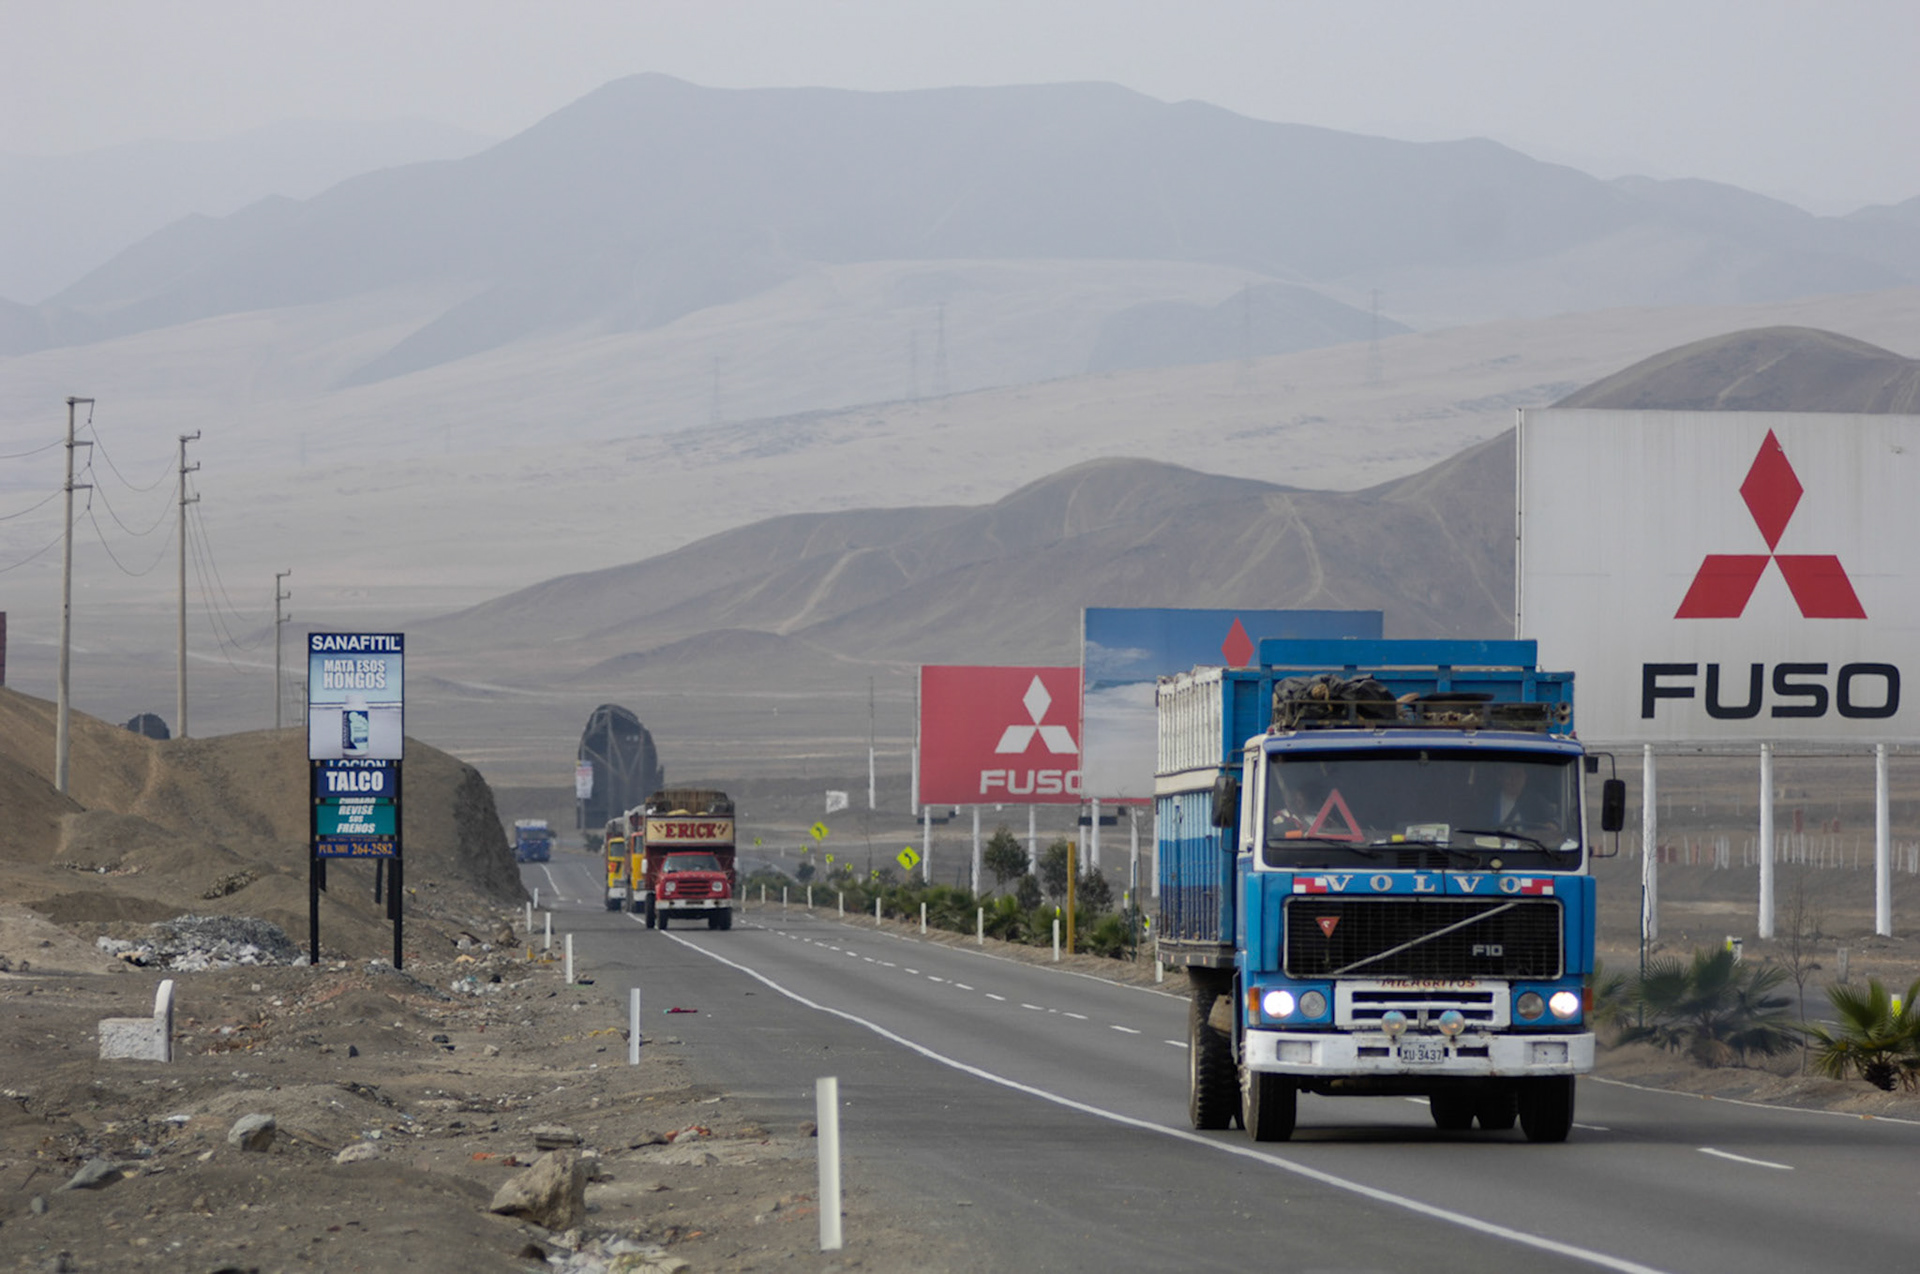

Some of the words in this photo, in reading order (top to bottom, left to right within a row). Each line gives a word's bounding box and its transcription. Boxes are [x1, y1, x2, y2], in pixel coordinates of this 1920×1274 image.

[324, 660, 355, 672] MATA
[357, 660, 385, 672] ESOS
[323, 672, 386, 689] HONGOS
[1641, 663, 1900, 719] FUSO
[326, 771, 384, 792] TALCO
[338, 805, 374, 815] REVISE
[336, 823, 375, 833] FRENOS
[352, 843, 393, 855] 264-2582
[1323, 875, 1522, 893] VOLVO
[1472, 945, 1503, 957] F10
